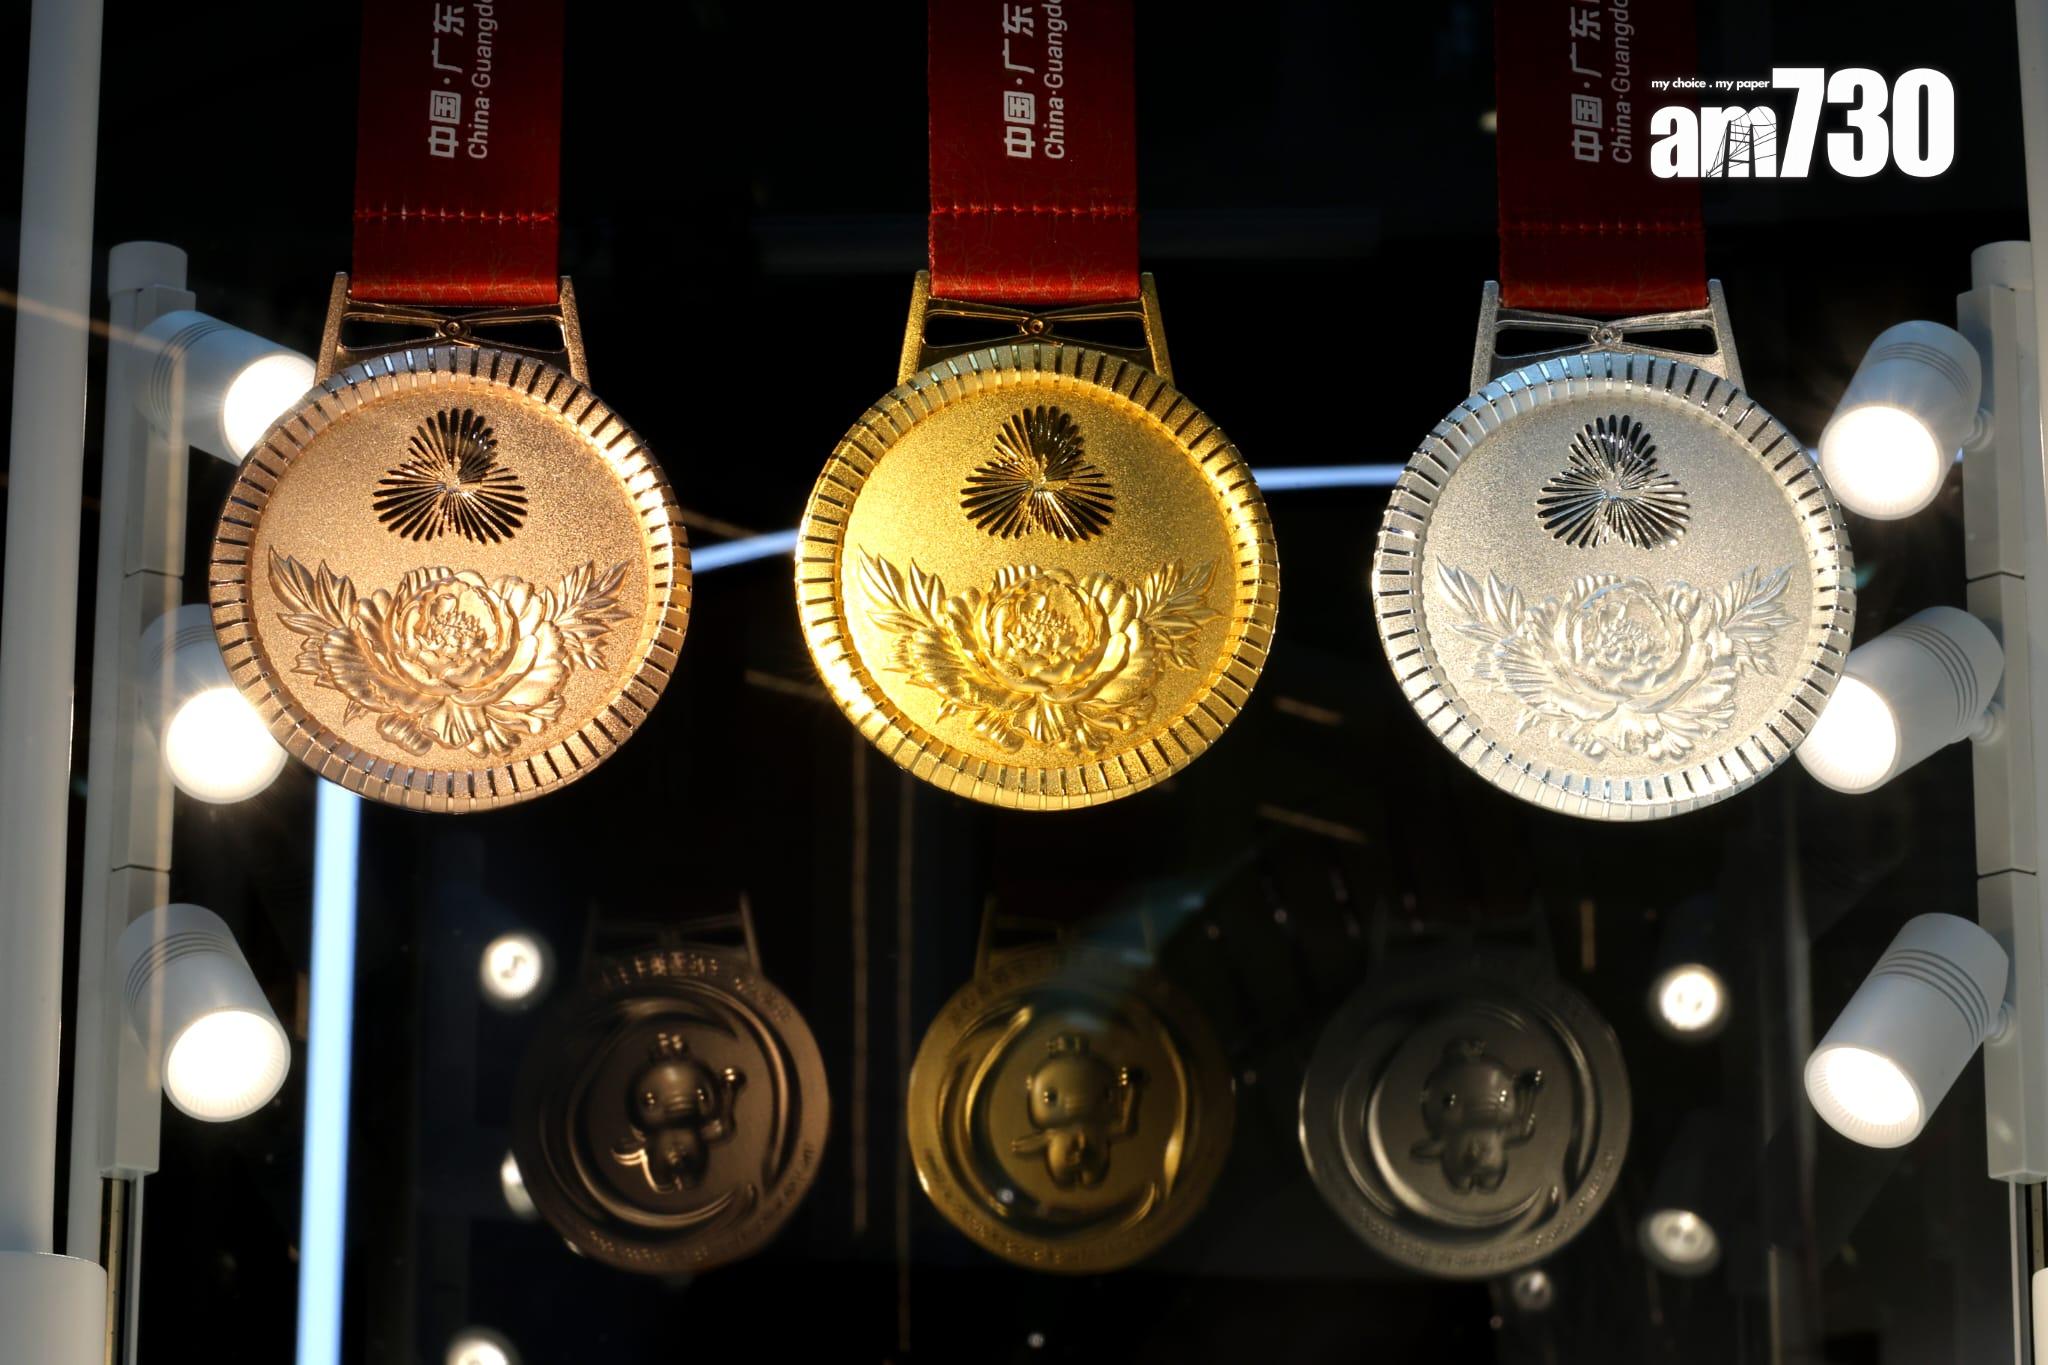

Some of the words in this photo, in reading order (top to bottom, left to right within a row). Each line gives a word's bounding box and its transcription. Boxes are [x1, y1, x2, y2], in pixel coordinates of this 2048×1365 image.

[468, 0, 498, 159] China·Guangd
[1042, 0, 1068, 159] China·Guangd
[1569, 0, 1604, 163] 中国·广东
